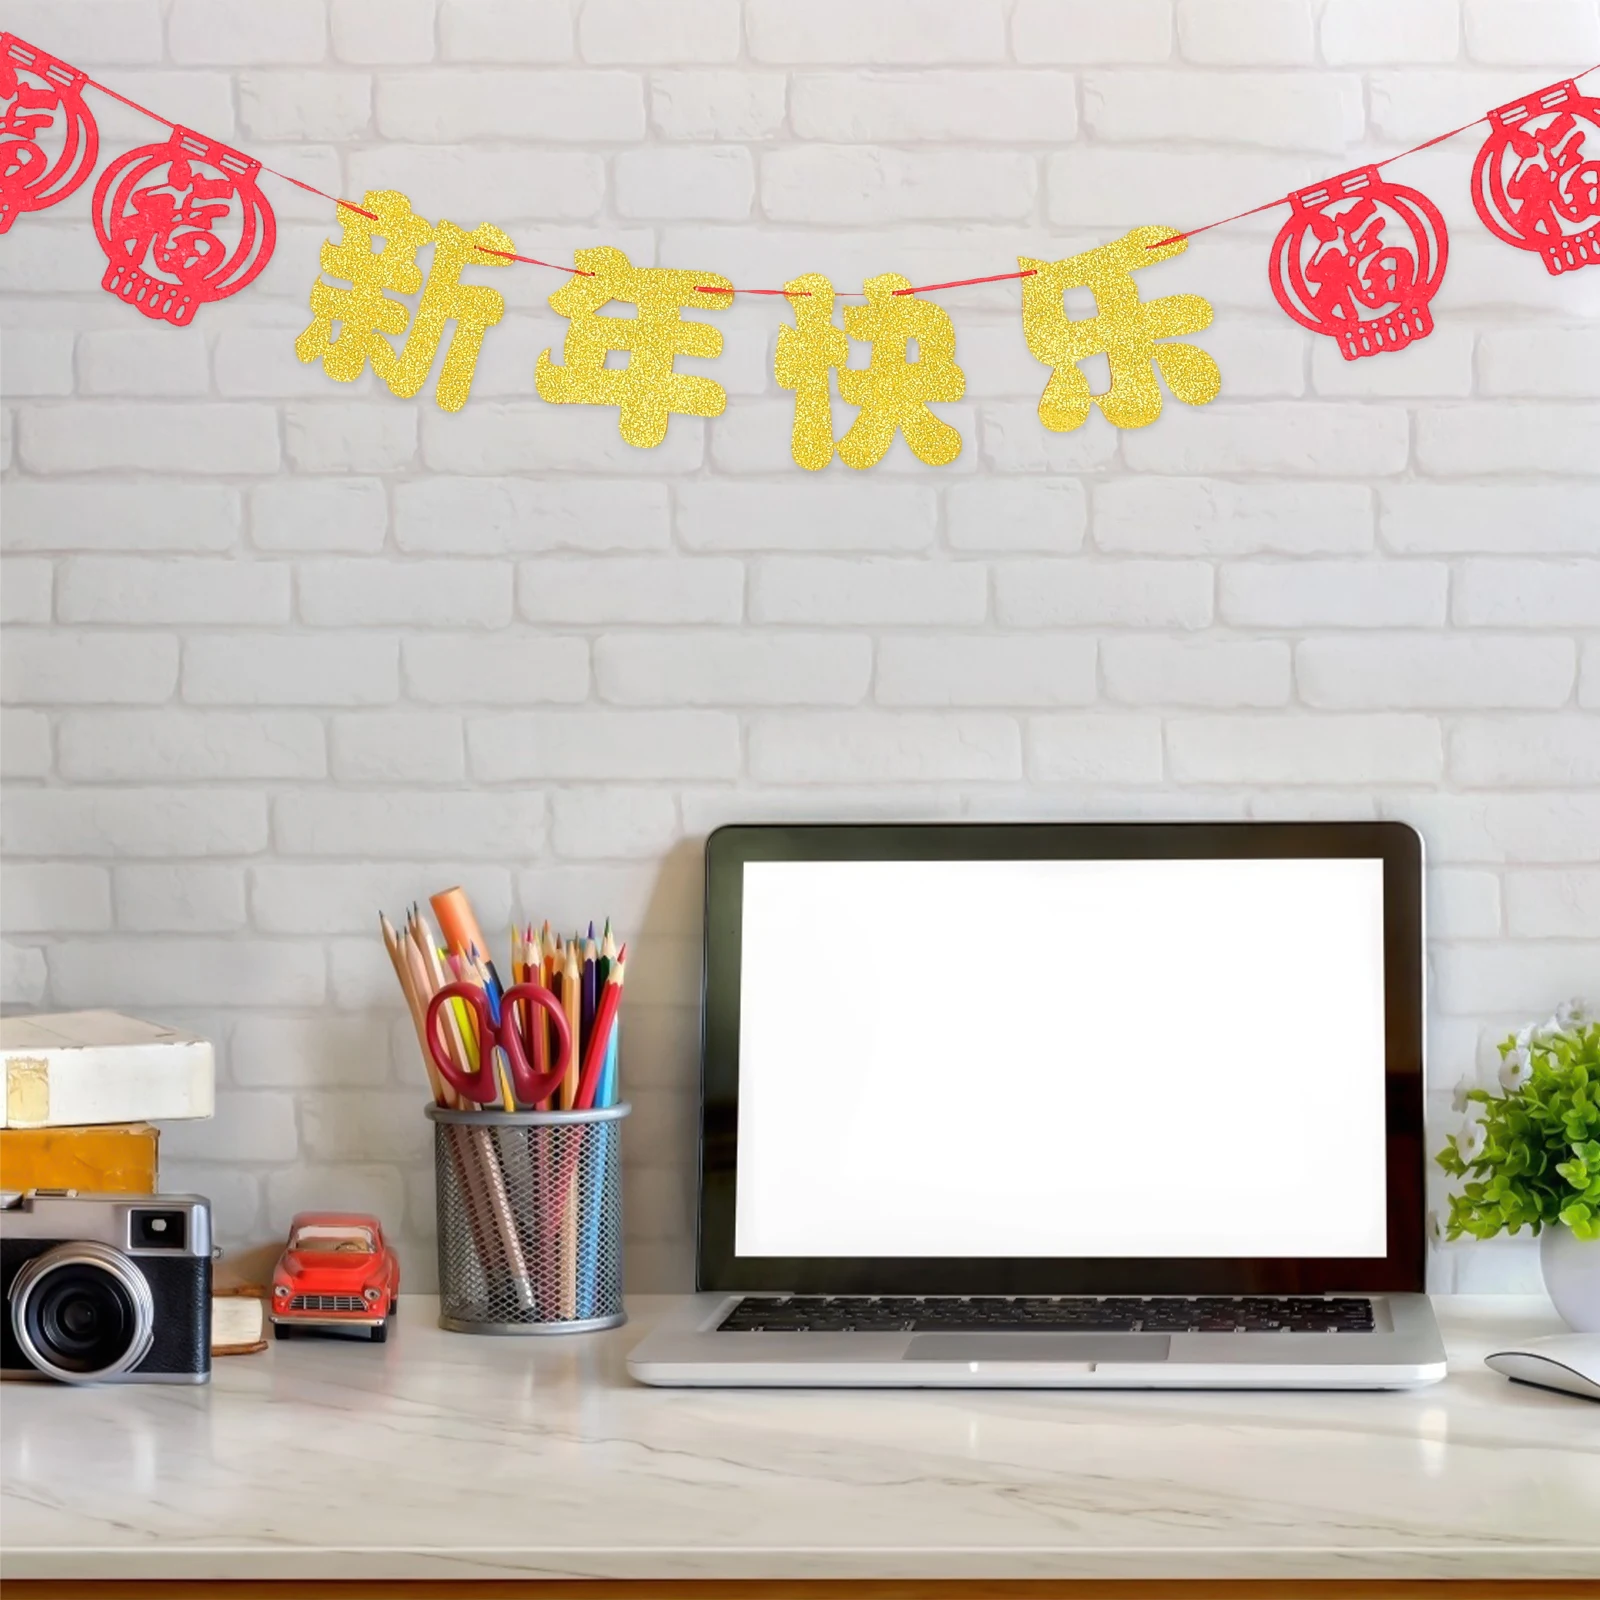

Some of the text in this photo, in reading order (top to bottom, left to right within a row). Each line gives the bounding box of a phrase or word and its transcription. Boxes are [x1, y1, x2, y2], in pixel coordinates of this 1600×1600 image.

[118, 158, 236, 282] 福
[1304, 199, 1416, 322] 福
[295, 190, 1221, 471] 新年快乐
